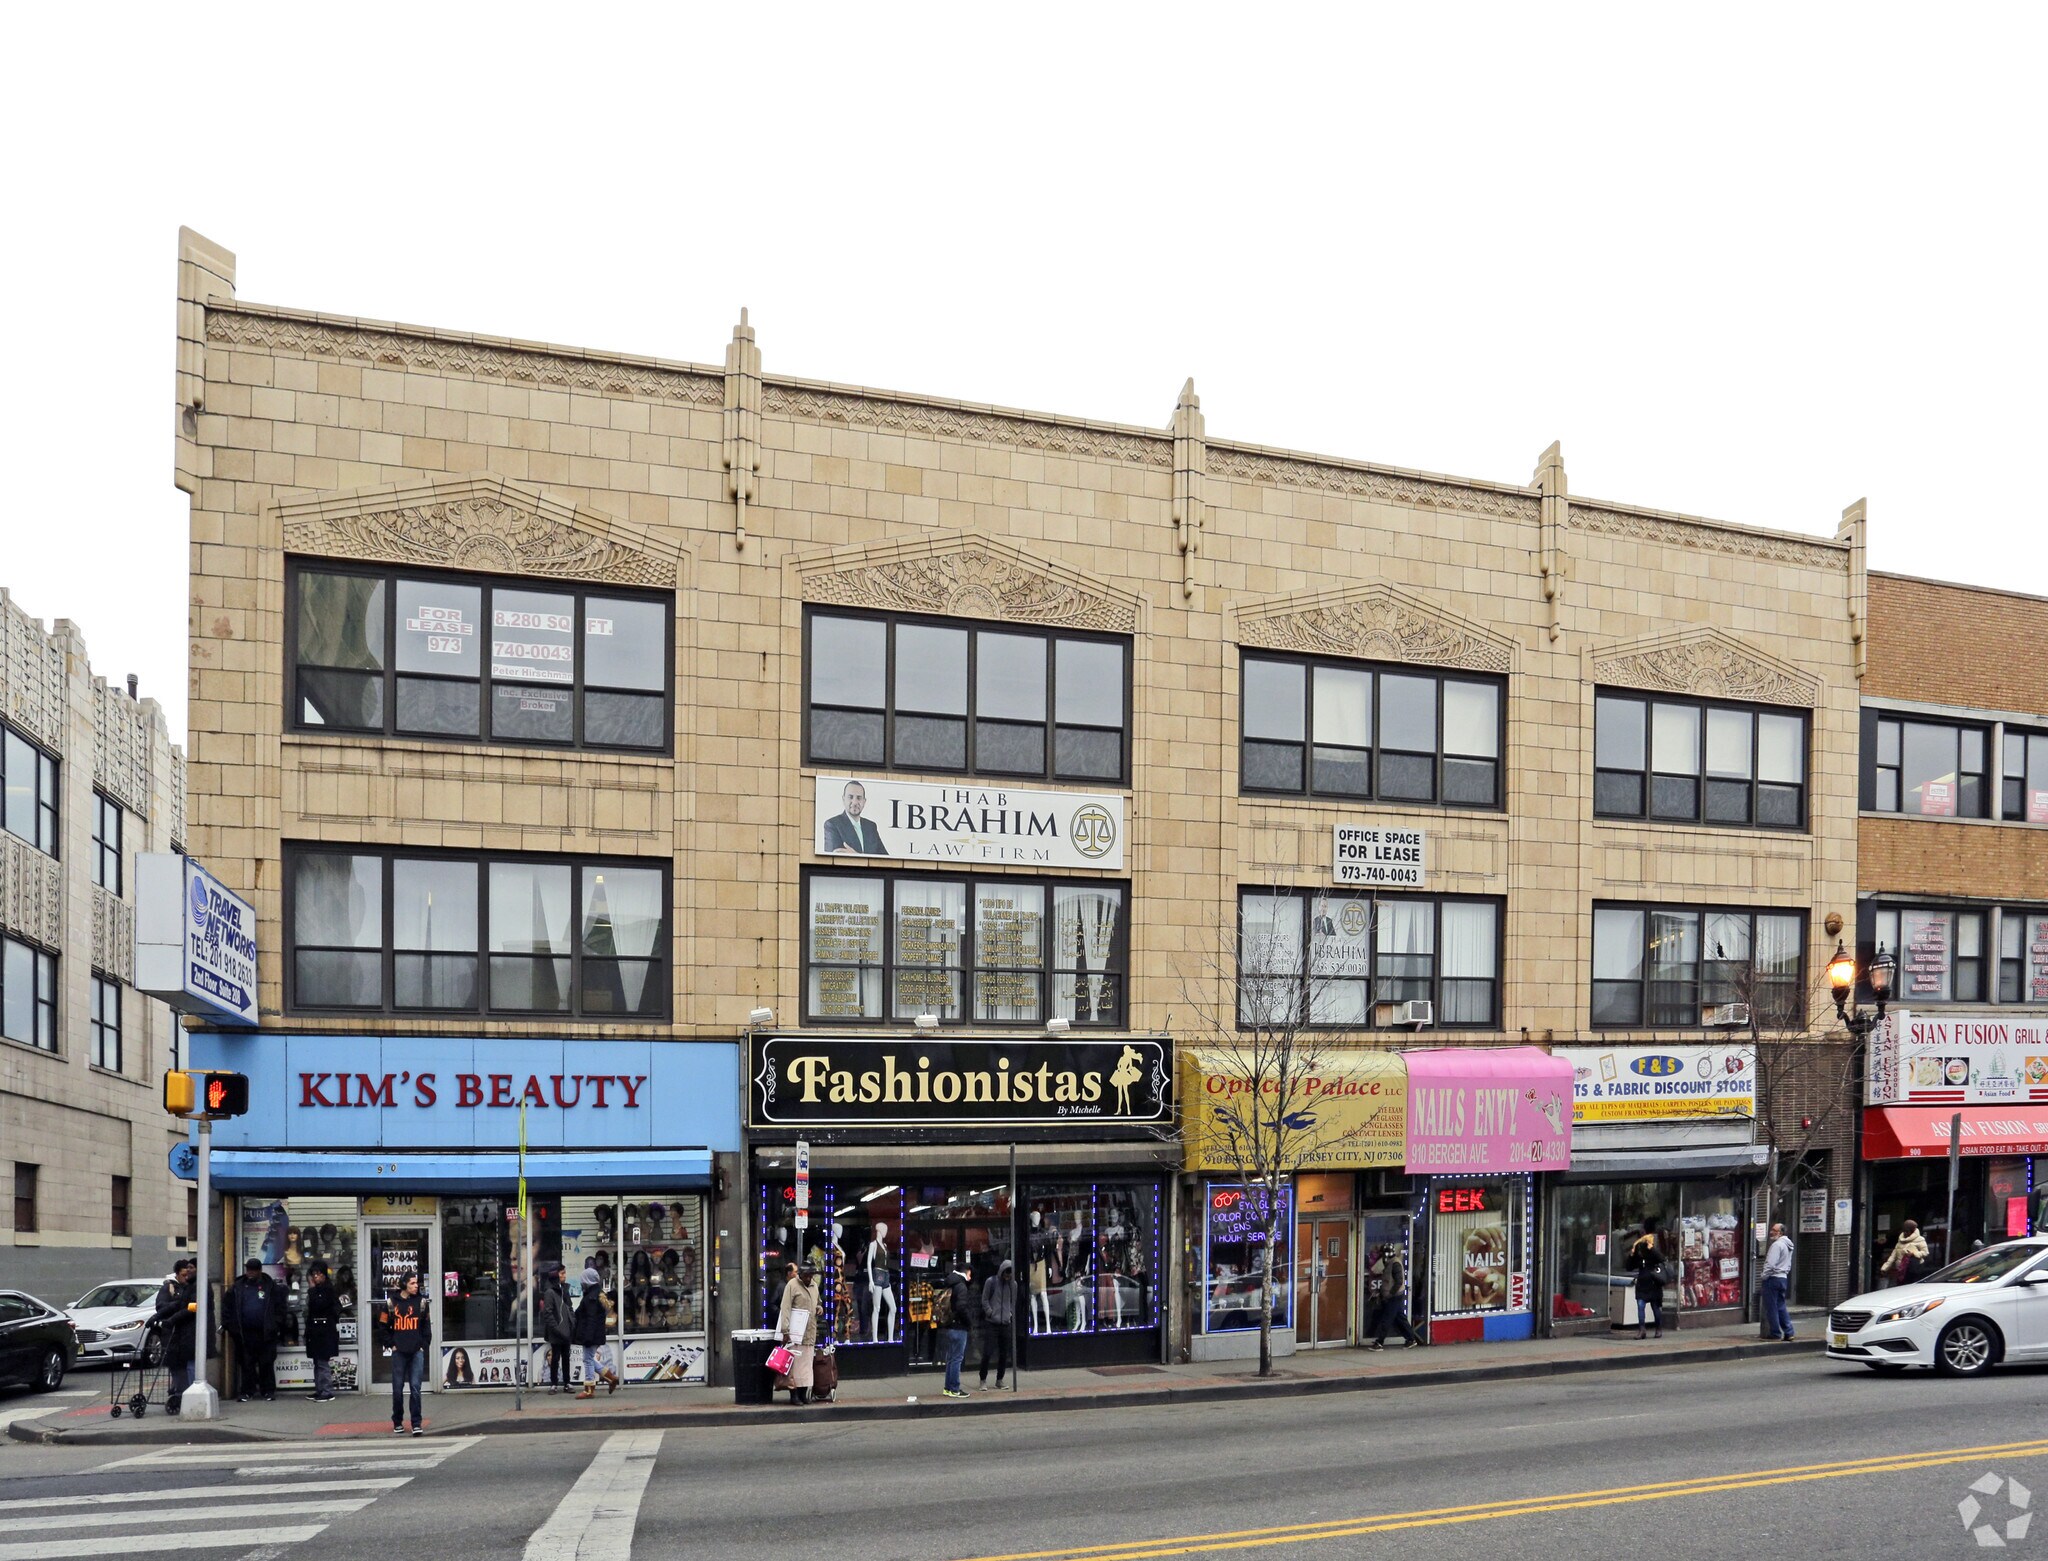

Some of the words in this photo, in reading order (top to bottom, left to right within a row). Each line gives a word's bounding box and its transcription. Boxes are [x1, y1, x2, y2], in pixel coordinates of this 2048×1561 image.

[420, 608, 461, 620] FOR
[407, 620, 472, 634] LEASE
[495, 613, 541, 627] 8,280
[547, 616, 570, 630] SQ
[587, 620, 612, 634] FT.
[430, 637, 460, 652] 973
[494, 643, 570, 659] 740-0043
[493, 666, 519, 676] Peter
[521, 668, 573, 680] Hirschman
[521, 689, 568, 700] Exclusive
[521, 701, 554, 710] Broker
[941, 789, 1008, 806] IHAB
[888, 799, 1061, 838] IBRAHIM
[1339, 829, 1379, 843] OFFICE
[1385, 832, 1420, 845] SPACE
[910, 842, 964, 856] LAW
[982, 845, 1050, 861] FIRM
[1339, 844, 1367, 859] FOR
[1375, 847, 1420, 862] LEASE
[1341, 866, 1418, 882] 973-740-0043
[210, 888, 241, 930] TRAVEL
[204, 930, 219, 948] ERA
[206, 911, 256, 962] NETWORKS
[191, 932, 208, 962] TEL:
[210, 945, 222, 970] 201
[224, 953, 236, 978] 918
[194, 966, 204, 985] 2nd
[204, 971, 218, 993] Floor
[1884, 1015, 1892, 1051] ASIAN
[1955, 1024, 2008, 1044] FUSION
[2015, 1028, 2041, 1044] GRILL
[1638, 1059, 1646, 1073] F
[1651, 1059, 1661, 1074] &
[1667, 1058, 1675, 1072] S
[786, 1056, 1102, 1103] Fashionistas
[1206, 1074, 1298, 1099] Optcal
[1303, 1075, 1381, 1097] Palace
[1883, 1057, 1892, 1100] FUSION
[299, 1070, 437, 1108] KIM'S
[455, 1073, 647, 1108] BEAUTY
[1593, 1084, 1603, 1096] &
[1608, 1083, 1650, 1095] FABRIC
[1655, 1081, 1711, 1095] DISCOUNT
[1717, 1080, 1752, 1092] STORE
[1057, 1105, 1069, 1116] By
[1070, 1104, 1101, 1114] Michelle
[1414, 1088, 1465, 1137] NAILS
[1474, 1088, 1519, 1136] ENVY
[1931, 1120, 1977, 1137] ASAN
[1976, 1119, 2032, 1136] FUSION
[1205, 1155, 1222, 1164] 910
[1299, 1152, 1333, 1164] JERSEY
[1336, 1152, 1361, 1162] CITY,
[1364, 1152, 1375, 1163] NJ
[1377, 1152, 1403, 1160] 07306
[1412, 1144, 1426, 1164] 910
[1428, 1143, 1467, 1164] BERGEN
[1469, 1143, 1489, 1164] AVE.
[1510, 1140, 1566, 1163] 201-420-4330
[1910, 1148, 1921, 1156] 900
[1962, 1146, 1978, 1154] ASIAN
[1980, 1145, 1994, 1153] FOOD
[1996, 1145, 2005, 1153] EAT
[2016, 1145, 2029, 1153] TAKE
[2030, 1144, 2041, 1152] OUT
[387, 1196, 413, 1205] 910
[1440, 1189, 1485, 1212] EEK
[244, 1210, 266, 1219] PURE
[1213, 1212, 1241, 1223] COLOR
[1228, 1221, 1251, 1233] LENS
[1218, 1234, 1242, 1243] HOUR
[1465, 1251, 1505, 1267] NAILS
[1512, 1275, 1524, 1307] ATM
[394, 1317, 419, 1330] HUNT
